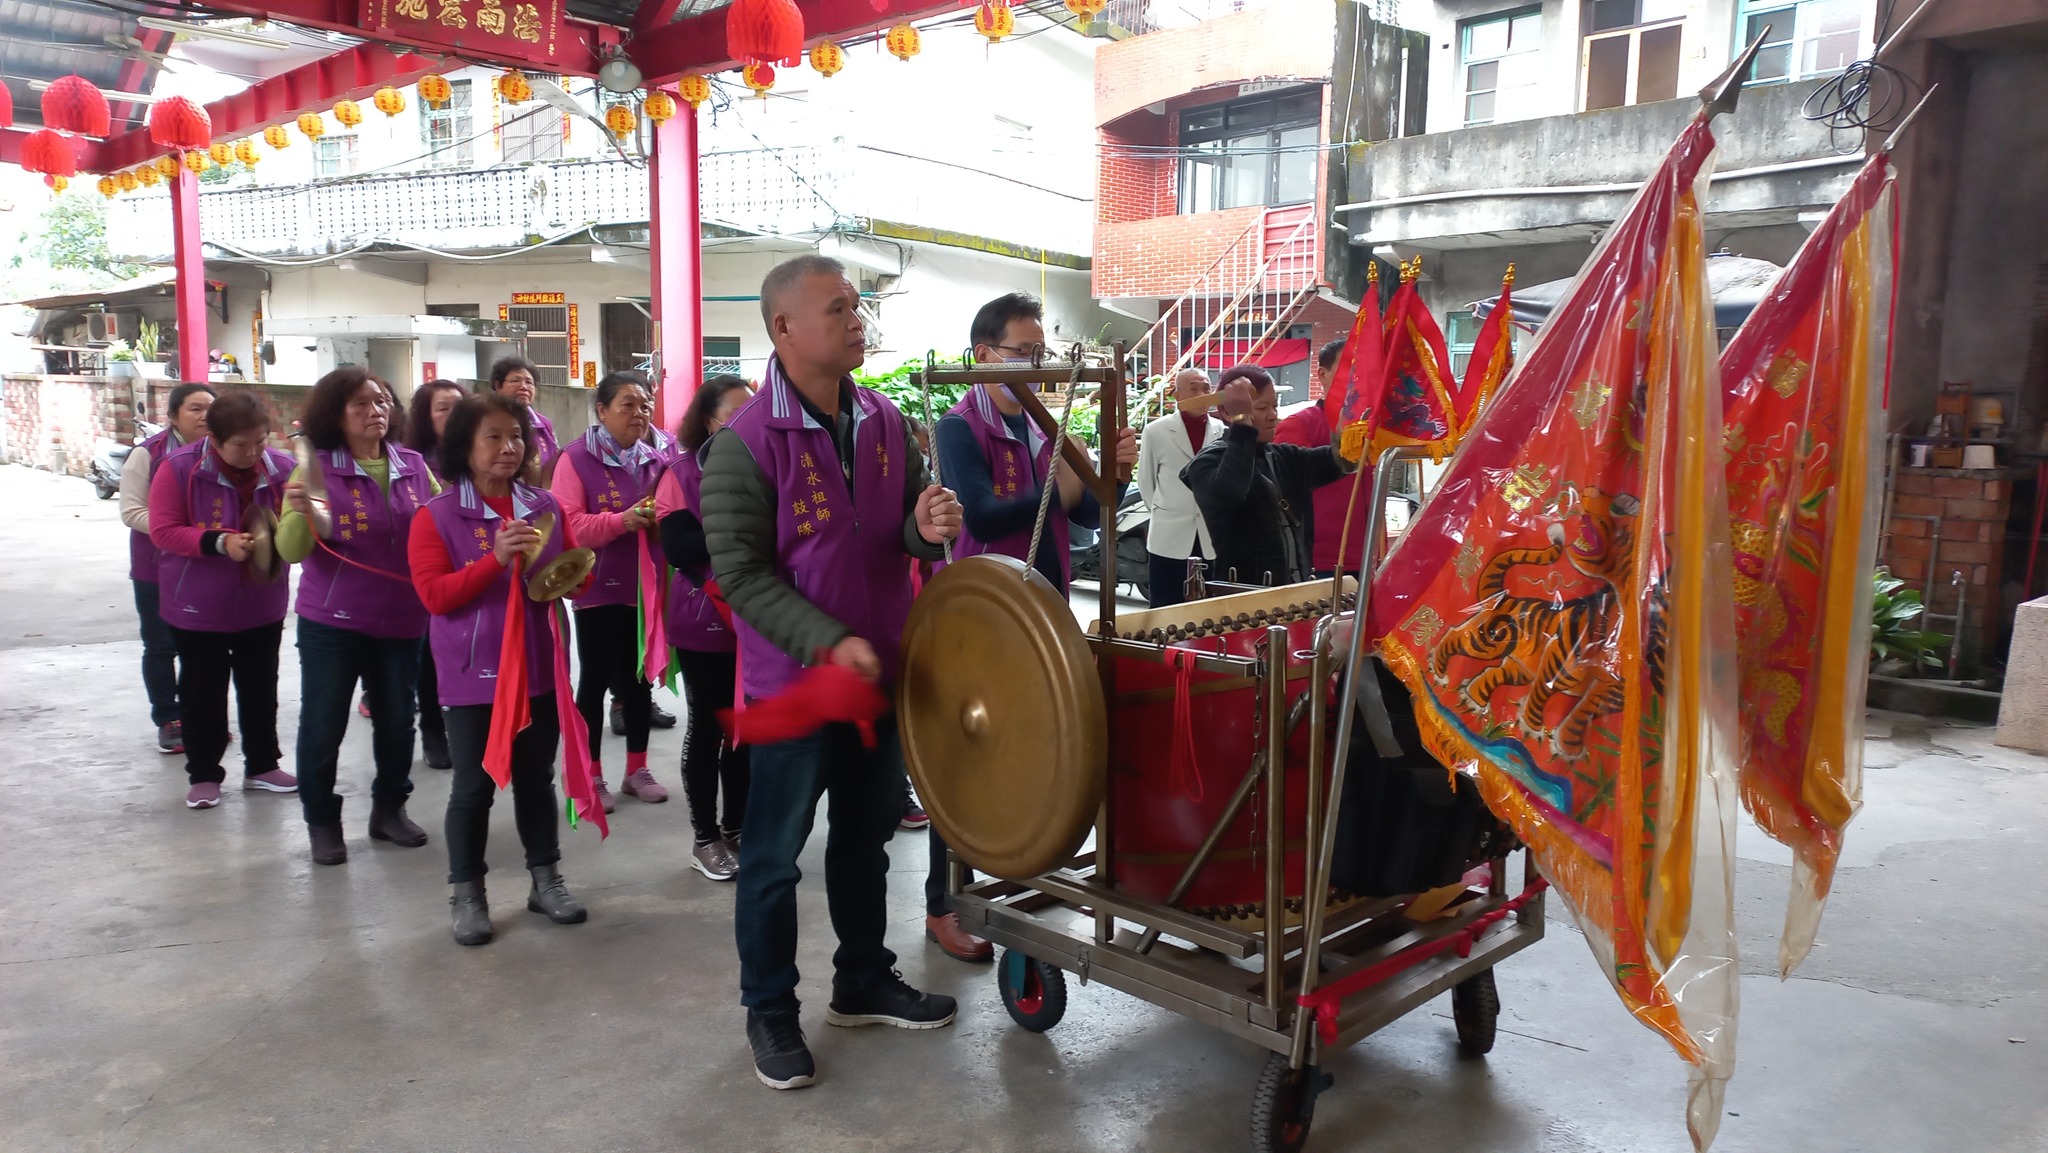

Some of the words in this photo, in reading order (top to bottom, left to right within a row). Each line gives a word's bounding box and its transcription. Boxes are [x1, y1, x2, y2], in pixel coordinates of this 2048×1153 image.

[800, 451, 831, 522] 清水祖師
[792, 498, 816, 537] 鼓隊
[474, 527, 493, 559] 清水
